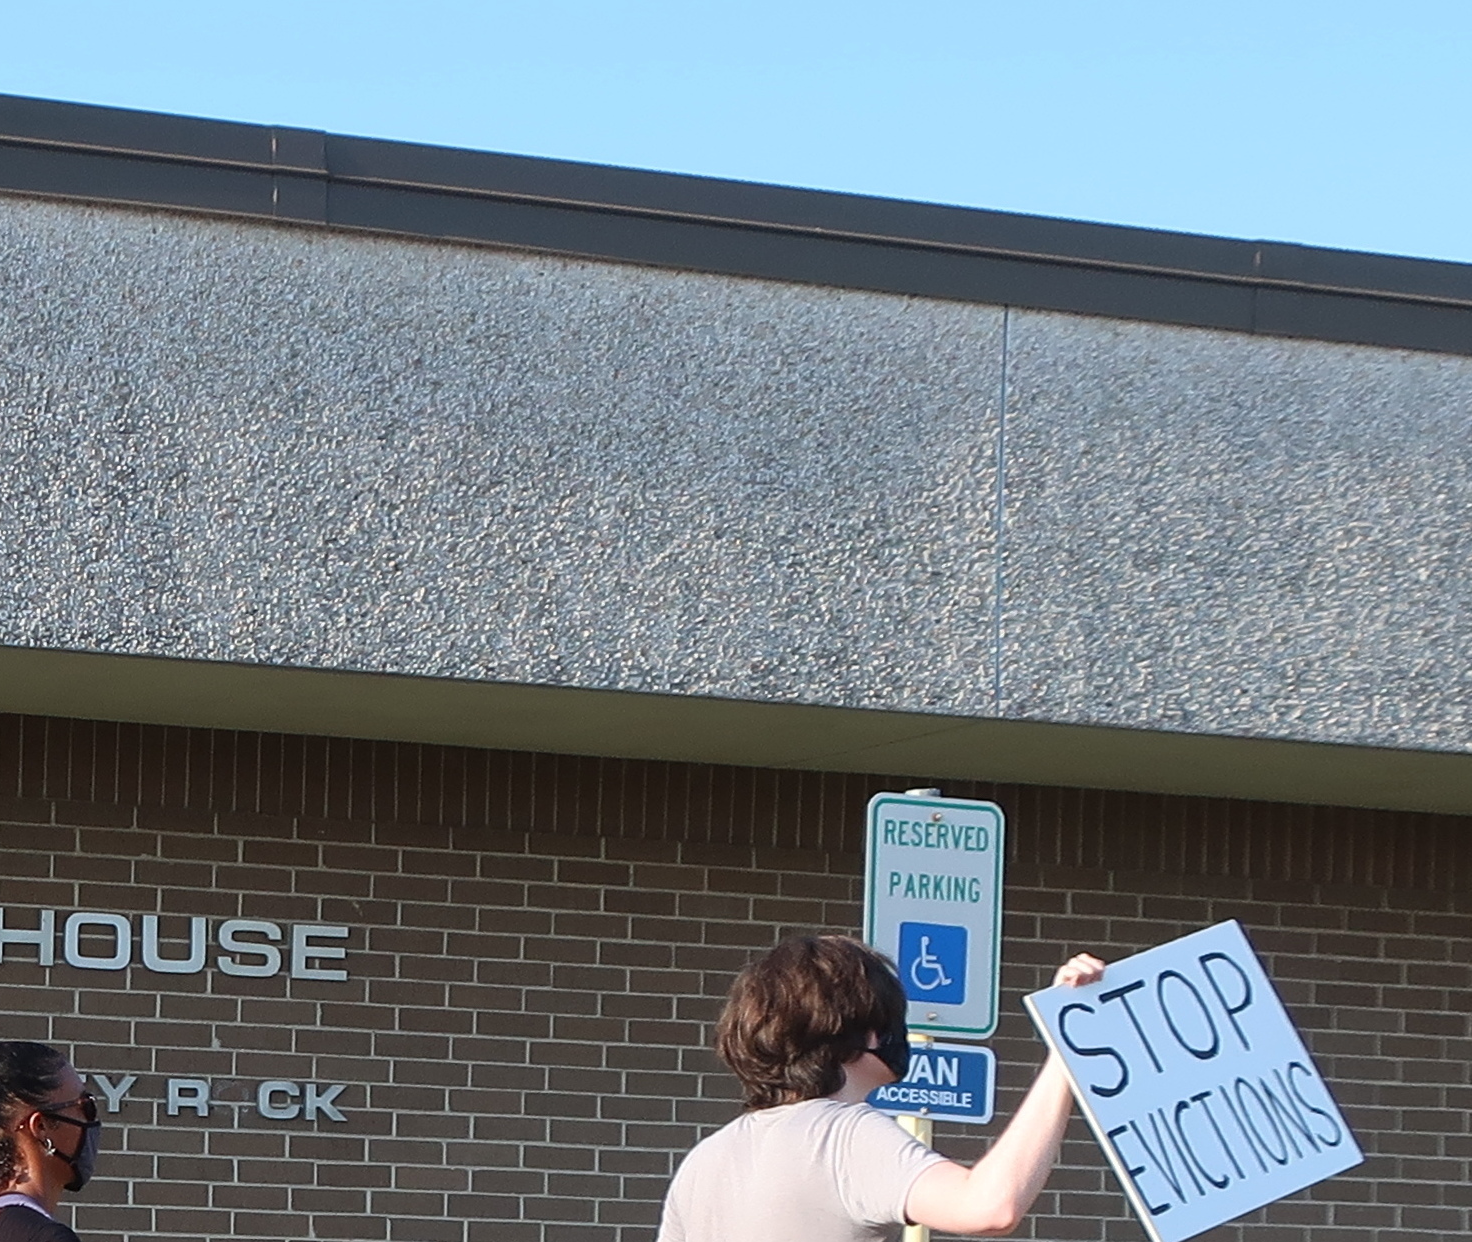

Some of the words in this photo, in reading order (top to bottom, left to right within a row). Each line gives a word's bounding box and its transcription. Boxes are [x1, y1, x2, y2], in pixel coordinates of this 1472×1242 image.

[884, 819, 989, 851] RESERVED
[889, 872, 981, 903] PARKING
[1058, 952, 1252, 1098] STOP
[876, 1086, 972, 1108] ACCESSIBLE
[1106, 1061, 1342, 1216] EVICTIONS
